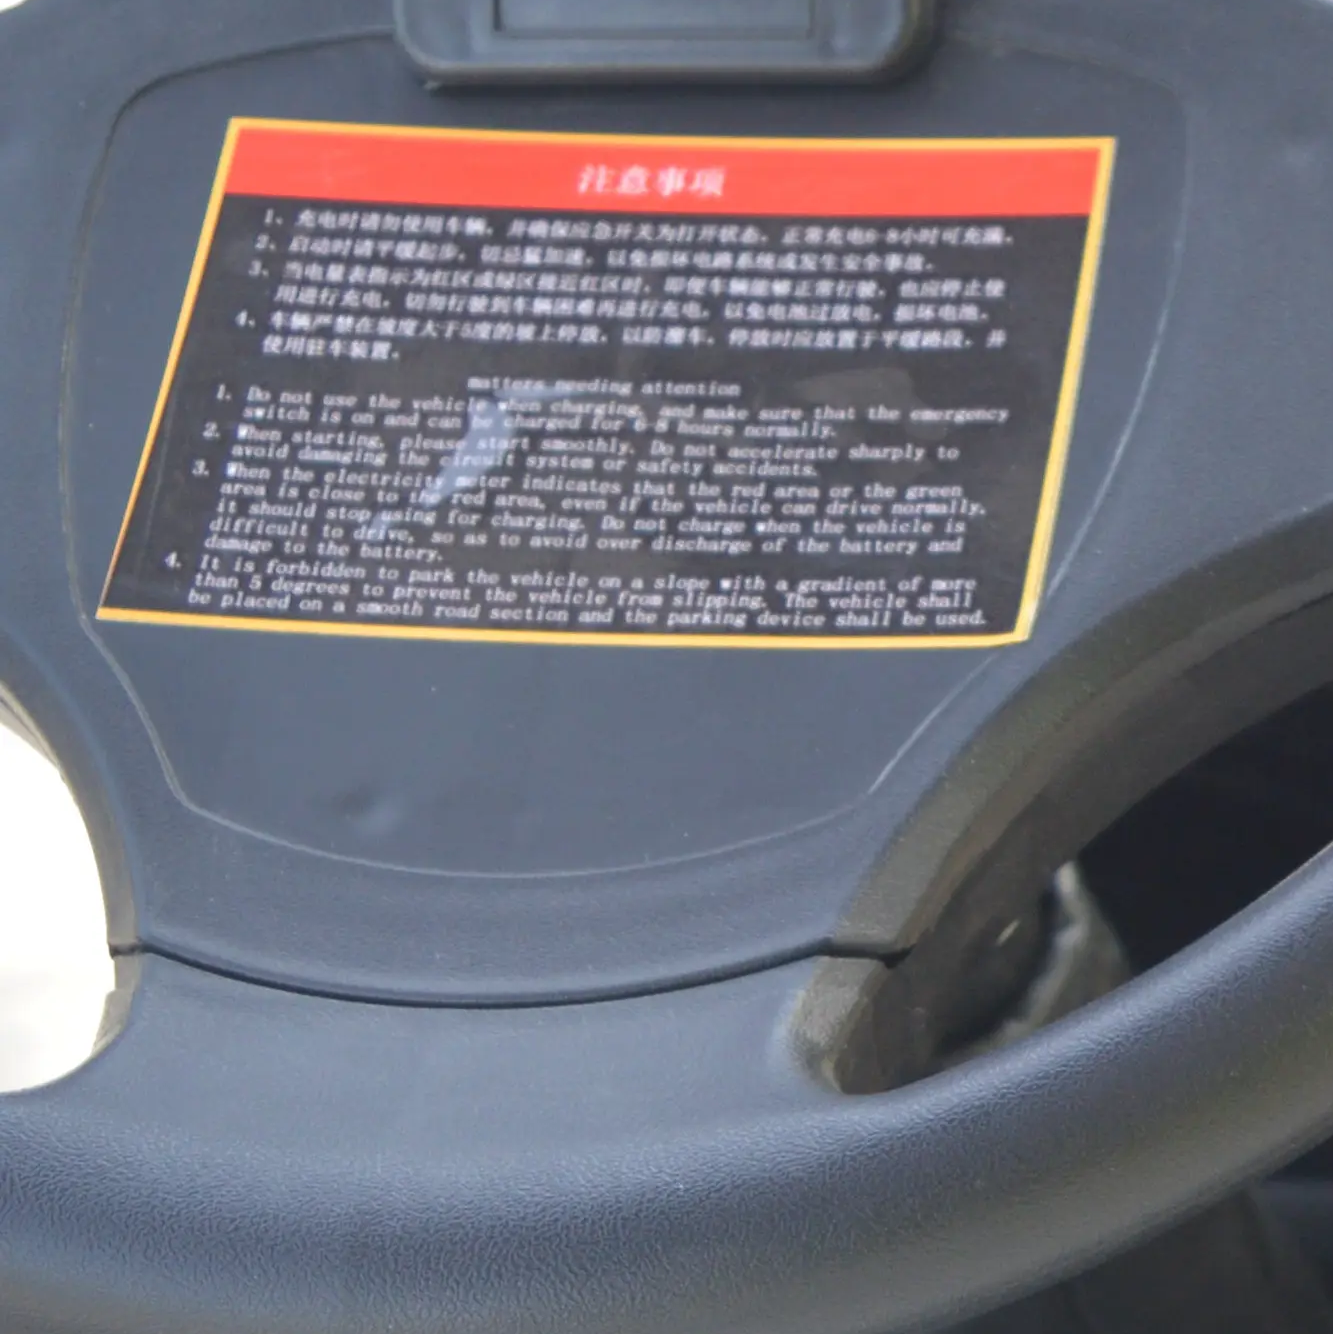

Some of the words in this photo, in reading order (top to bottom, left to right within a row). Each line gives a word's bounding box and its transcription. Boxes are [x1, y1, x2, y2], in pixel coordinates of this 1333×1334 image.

[578, 163, 726, 198] 注意事项
[467, 375, 545, 391] matters
[554, 377, 632, 396] needing
[641, 380, 740, 395] attention
[244, 404, 311, 420] switch
[320, 407, 342, 422] is
[350, 412, 376, 424] on
[384, 411, 419, 426] and
[426, 415, 463, 427] can
[469, 412, 494, 427] be
[502, 413, 582, 432] charged
[590, 416, 619, 431] for
[676, 418, 736, 435] hours
[247, 385, 272, 401] Do
[279, 390, 313, 404] not
[322, 395, 357, 407] use
[367, 392, 401, 408] the
[411, 394, 488, 410] vehicle
[497, 395, 542, 411] when
[659, 402, 695, 417] and
[703, 403, 749, 418] make
[758, 408, 803, 419] sure
[813, 404, 856, 419] that
[868, 405, 900, 420] the
[910, 409, 1009, 424] emergency
[231, 445, 288, 460] avoid
[298, 446, 387, 467] damaging
[398, 450, 430, 465] the
[440, 451, 516, 466] circuit
[526, 455, 593, 471] system
[602, 459, 626, 470] or
[637, 456, 703, 475] safety
[236, 423, 283, 439] When
[400, 432, 467, 449] please
[477, 436, 531, 451] start
[650, 439, 674, 455] Do
[684, 442, 717, 456] not
[728, 442, 838, 459] accelerate
[848, 444, 925, 462] sharply
[937, 445, 959, 459] to
[219, 484, 267, 497] area
[276, 485, 300, 499] is
[307, 486, 365, 502] close
[376, 489, 400, 503] to
[408, 489, 441, 504] the
[450, 490, 486, 505] red
[560, 498, 607, 510] even
[619, 496, 639, 511] if
[650, 496, 684, 512] the
[694, 498, 772, 514] vehicle
[781, 503, 816, 514] can
[826, 499, 881, 515] drive
[226, 462, 271, 479] When
[281, 465, 314, 481] the
[323, 468, 446, 488] electricity
[456, 473, 509, 488] meter
[522, 476, 622, 494] indicates
[632, 480, 676, 495] that
[687, 481, 721, 496] the
[730, 482, 765, 497] red
[774, 486, 821, 498] area
[829, 487, 852, 498] or
[863, 483, 896, 498] the
[905, 487, 962, 501] green
[216, 498, 238, 513] it
[248, 500, 317, 518] should
[326, 506, 372, 523] stop
[380, 508, 436, 526] using
[446, 509, 481, 525] for
[601, 515, 625, 530] Do
[634, 516, 668, 530] not
[678, 516, 745, 534] charge
[755, 517, 802, 532] when
[812, 517, 845, 532] the
[855, 517, 933, 532] vehicle
[944, 518, 966, 532] is
[204, 532, 273, 553] damage
[282, 538, 306, 553] to
[316, 539, 350, 555] the
[208, 516, 310, 536] difficult
[321, 523, 344, 537] to
[431, 531, 455, 542] so
[464, 532, 488, 544] as
[498, 531, 521, 546] to
[529, 534, 588, 549] avoid
[596, 538, 642, 550] over
[651, 535, 752, 554] discharge
[761, 536, 784, 551] of
[796, 536, 829, 551] the
[839, 536, 918, 555] battery
[928, 537, 963, 552] and
[193, 571, 239, 587] than
[248, 574, 263, 589] 5
[270, 575, 351, 595] degrees
[362, 581, 385, 596] to
[392, 585, 473, 599] prevent
[484, 586, 517, 601] the
[528, 588, 607, 605] vehicle
[616, 591, 663, 606] from
[785, 592, 818, 607] The
[828, 592, 907, 607] vehicle
[917, 592, 974, 607] shall
[199, 553, 222, 569] It
[233, 556, 256, 571] is
[265, 558, 367, 578] forbidden
[377, 565, 400, 579] to
[408, 567, 456, 583] park
[466, 569, 499, 584] the
[510, 571, 589, 588] vehicle
[597, 578, 622, 589] on
[630, 578, 645, 589] a
[653, 574, 710, 593] slope
[719, 576, 766, 591] with
[775, 580, 789, 591] a
[797, 576, 888, 594] gradient
[897, 576, 919, 591] of
[931, 580, 976, 591] more
[187, 588, 211, 604] be
[220, 590, 291, 608] placed
[298, 598, 323, 610] on
[332, 600, 347, 611] a
[356, 601, 424, 616] smooth
[433, 603, 480, 618] road
[490, 606, 569, 622] section
[578, 607, 614, 622] and
[624, 608, 657, 623] the
[666, 609, 747, 628] parking
[756, 610, 826, 625] device
[836, 610, 893, 625] shall
[902, 610, 926, 625] be
